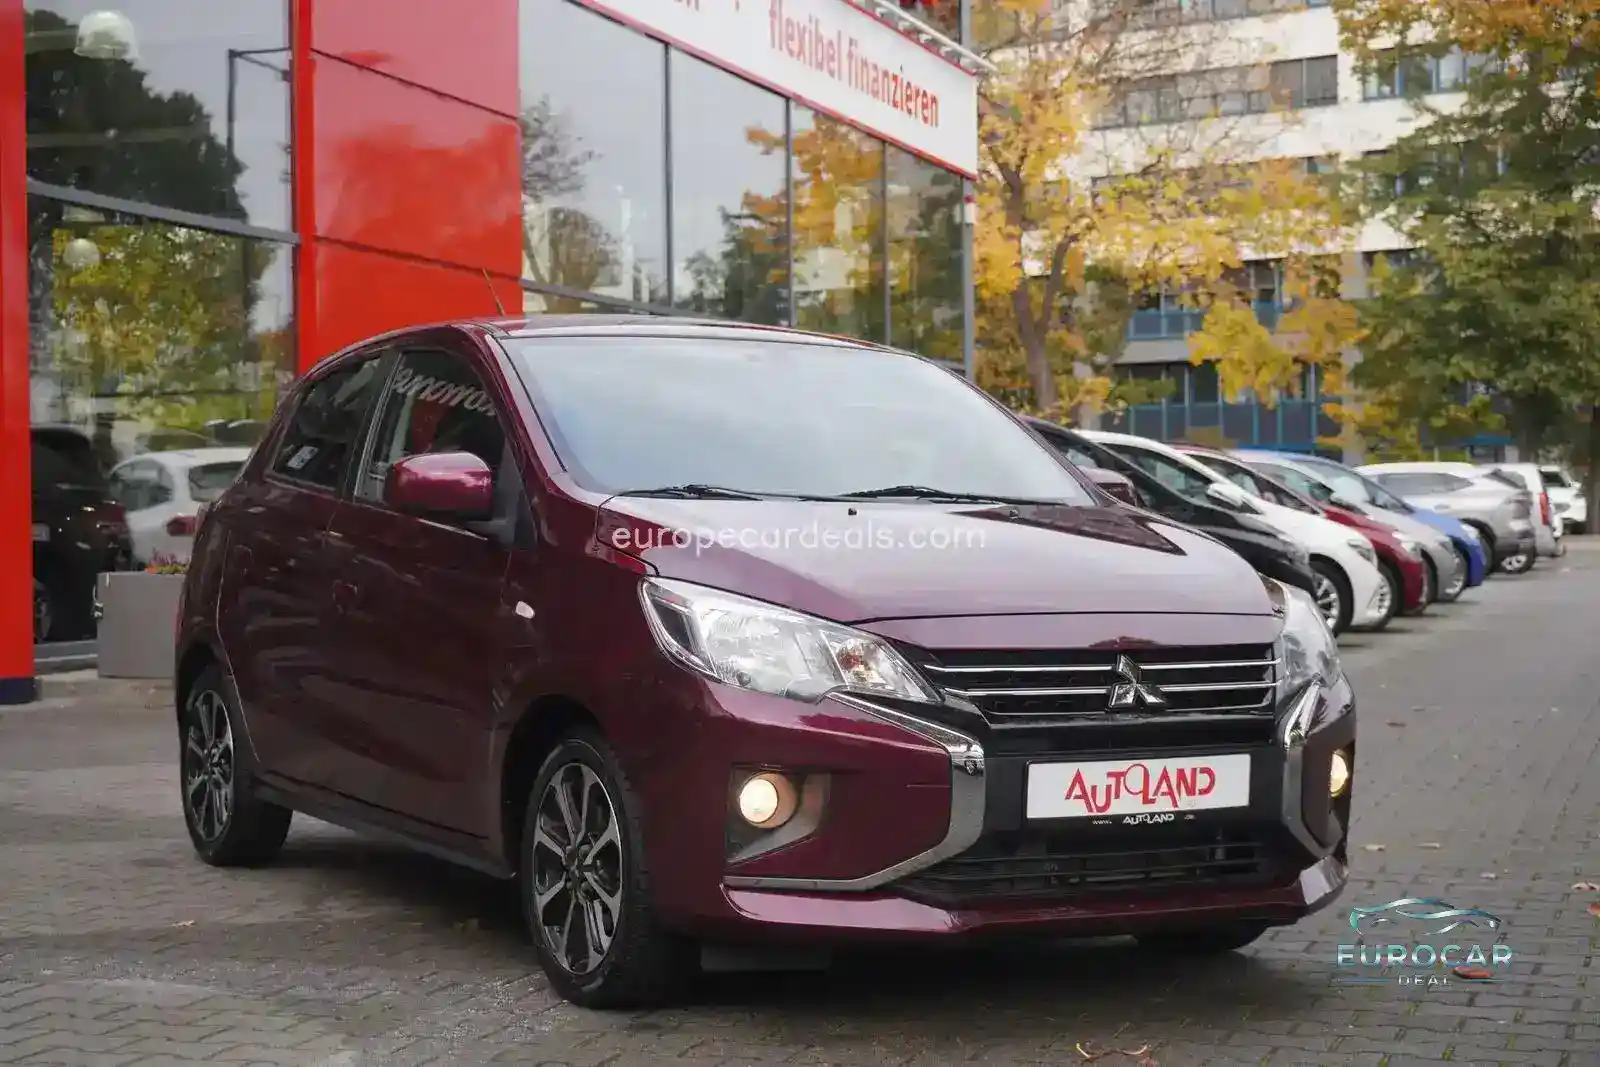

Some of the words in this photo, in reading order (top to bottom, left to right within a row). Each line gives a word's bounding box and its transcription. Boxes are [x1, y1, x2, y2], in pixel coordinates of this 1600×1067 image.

[769, 0, 843, 81] flexibel
[848, 37, 939, 128] finanzieren
[1066, 764, 1216, 813] AUTOLAND
